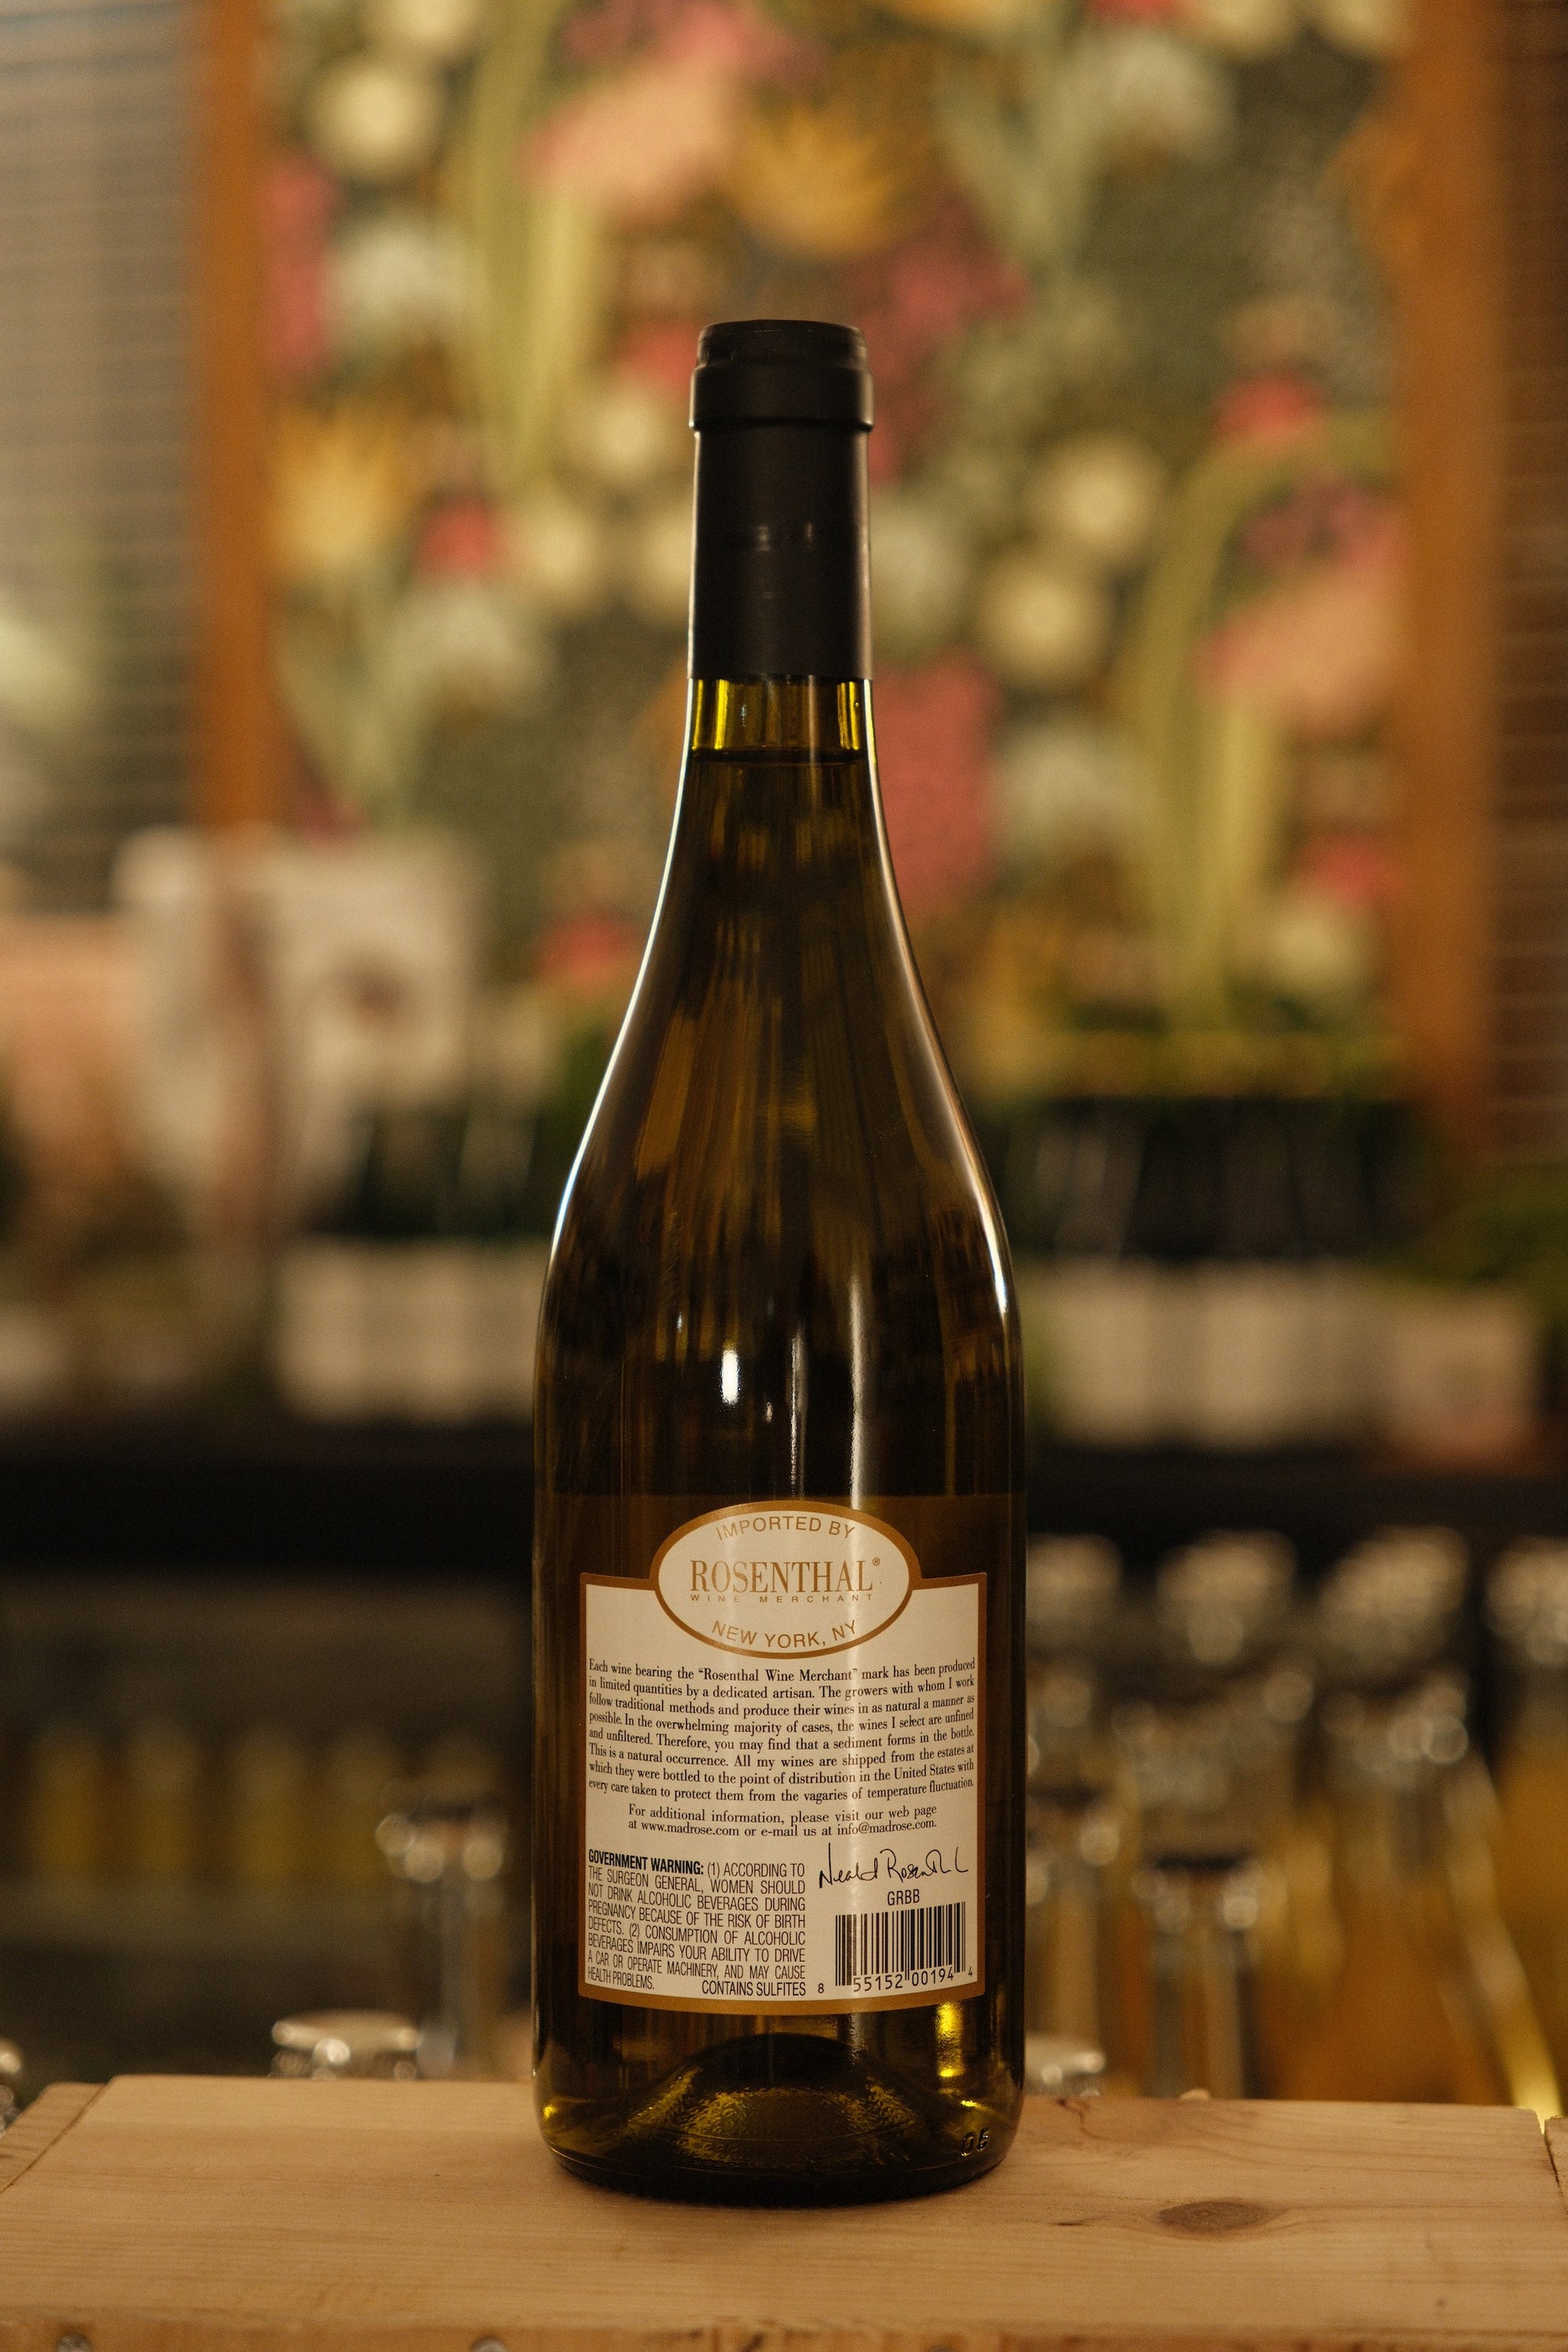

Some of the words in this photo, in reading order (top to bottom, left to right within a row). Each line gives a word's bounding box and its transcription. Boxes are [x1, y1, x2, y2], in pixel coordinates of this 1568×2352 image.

[716, 1515, 822, 1541] IMPORTED
[828, 1520, 855, 1539] BY
[690, 1594, 740, 1603] WINE
[760, 1593, 873, 1603] MERCHANT
[711, 1620, 757, 1645] NEW
[764, 1631, 826, 1649] YORK,
[832, 1620, 856, 1641] NY
[589, 1658, 608, 1672] Each
[610, 1662, 632, 1675] wine
[635, 1663, 673, 1682] bearing
[677, 1666, 694, 1679] the
[698, 1667, 759, 1681] “Rosenthal
[765, 1668, 794, 1681] Wine
[799, 1668, 858, 1681] Merchant”
[861, 1666, 889, 1679] mark
[892, 1665, 909, 1677] has
[914, 1664, 935, 1676] been
[938, 1657, 975, 1677] produced
[600, 1676, 630, 1691] limited
[633, 1682, 683, 1697] quantities
[712, 1685, 768, 1698] dedicated
[772, 1686, 815, 1698] artisan.
[818, 1686, 841, 1697] The
[844, 1686, 888, 1701] growers
[891, 1681, 913, 1694] with
[916, 1679, 945, 1692] whom
[955, 1674, 974, 1687] work
[589, 1692, 613, 1707] follow
[615, 1697, 664, 1711] traditional
[669, 1700, 715, 1715] methods
[717, 1702, 739, 1715] and
[743, 1703, 789, 1719] produce
[793, 1703, 821, 1715] their
[823, 1703, 855, 1715] wines
[885, 1697, 920, 1711] natural
[931, 1696, 964, 1708] manner
[590, 1711, 622, 1725] possible.
[637, 1714, 653, 1728] the
[655, 1718, 729, 1736] overwhelming
[734, 1721, 782, 1737] majority
[801, 1723, 833, 1734] cases,
[837, 1719, 854, 1731] the
[858, 1719, 887, 1730] wines
[898, 1715, 925, 1728] select
[928, 1715, 942, 1725] are
[945, 1707, 974, 1723] unfined
[589, 1726, 603, 1739] and
[606, 1729, 653, 1744] unfiltered.
[655, 1733, 710, 1751] Therefore,
[713, 1740, 735, 1753] you
[739, 1741, 764, 1754] may
[768, 1737, 791, 1750] find
[795, 1737, 818, 1750] that
[833, 1736, 883, 1749] sediment
[887, 1733, 916, 1746] forms
[933, 1729, 947, 1741] the
[950, 1725, 975, 1739] bottle.
[590, 1742, 607, 1756] This
[626, 1750, 662, 1762] natural
[665, 1755, 728, 1766] occurrence.
[733, 1754, 751, 1766] All
[780, 1755, 814, 1767] wines
[818, 1758, 837, 1766] are
[842, 1751, 886, 1769] shipped
[891, 1750, 915, 1762] from
[919, 1747, 935, 1760] the
[937, 1746, 965, 1758] estates
[589, 1759, 613, 1774] which
[615, 1762, 634, 1780] they
[637, 1769, 660, 1779] were
[662, 1767, 700, 1782] bottled
[717, 1770, 736, 1784] the
[739, 1772, 770, 1788] point
[788, 1771, 855, 1784] distribution
[873, 1768, 891, 1781] the
[894, 1764, 927, 1780] United
[929, 1763, 955, 1776] States
[956, 1758, 974, 1772] with
[588, 1780, 608, 1794] every
[610, 1783, 629, 1793] care
[631, 1782, 657, 1796] taken
[674, 1789, 711, 1802] protect
[715, 1788, 744, 1801] them
[748, 1788, 776, 1801] from
[780, 1788, 799, 1801] the
[803, 1788, 848, 1805] vagaries
[867, 1784, 927, 1801] temperature
[929, 1777, 974, 1792] fluctuation.
[629, 1803, 646, 1817] For
[649, 1806, 706, 1821] additional
[711, 1809, 784, 1825] information,
[790, 1811, 829, 1826] please
[834, 1809, 859, 1821] visit
[864, 1811, 884, 1820] our
[887, 1806, 909, 1818] web
[914, 1806, 937, 1820] page
[760, 1824, 798, 1836] e-mail
[588, 1848, 648, 1869] GOVERNMENT
[650, 1857, 704, 1875] WARNING:
[707, 1861, 720, 1879] (1)
[723, 1862, 787, 1877] ACCORDING
[792, 1863, 805, 1877] TO
[588, 1864, 603, 1881] THE
[606, 1868, 648, 1887] SURGEON
[654, 1874, 703, 1894] GENERAL,
[710, 1878, 753, 1893] WOMEN
[760, 1879, 805, 1894] SHOULD
[588, 1882, 604, 1897] NOT
[607, 1885, 633, 1903] DRINK
[637, 1889, 691, 1908] ALCOHOLIC
[697, 1894, 759, 1911] BEVERAGES
[764, 1896, 805, 1911] DURING
[887, 1889, 920, 1906] GRBB
[588, 1898, 636, 1919] PREGNANCY
[638, 1906, 682, 1925] BECAUSE
[685, 1911, 699, 1926] OF
[703, 1911, 724, 1927] THE
[728, 1913, 752, 1928] RISK
[756, 1914, 770, 1928] OF
[775, 1914, 805, 1929] BIRTH
[588, 1915, 624, 1935] DEFECTS.
[629, 1922, 640, 1940] (2)
[644, 1924, 717, 1944] CONSUMPTION
[724, 1929, 738, 1944] OF
[743, 1930, 805, 1945] ALCOHOLIC
[588, 1932, 633, 1953] BEVERAGES
[637, 1939, 675, 1958] IMPAIRS
[679, 1944, 706, 1960] YOUR
[710, 1947, 750, 1962] ABILITY
[754, 1947, 769, 1962] TO
[774, 1947, 805, 1962] DRIVE
[588, 1965, 611, 1983] HEALTH
[612, 1970, 655, 1990] PROBLEMS.
[595, 1950, 609, 1966] CAR
[627, 1955, 662, 1973] OPERATE
[666, 1960, 719, 1981] MACHINERY,
[724, 1964, 743, 1979] AND
[749, 1965, 769, 1979] MAY
[775, 1965, 805, 1980] CAUSE
[701, 1980, 753, 1996] CONTAINS
[756, 1981, 806, 1996] SULFITES
[818, 1983, 825, 1994] 8
[853, 1974, 903, 1993] 55152
[912, 1967, 954, 1987] 00194
[967, 1966, 973, 1976] 4
